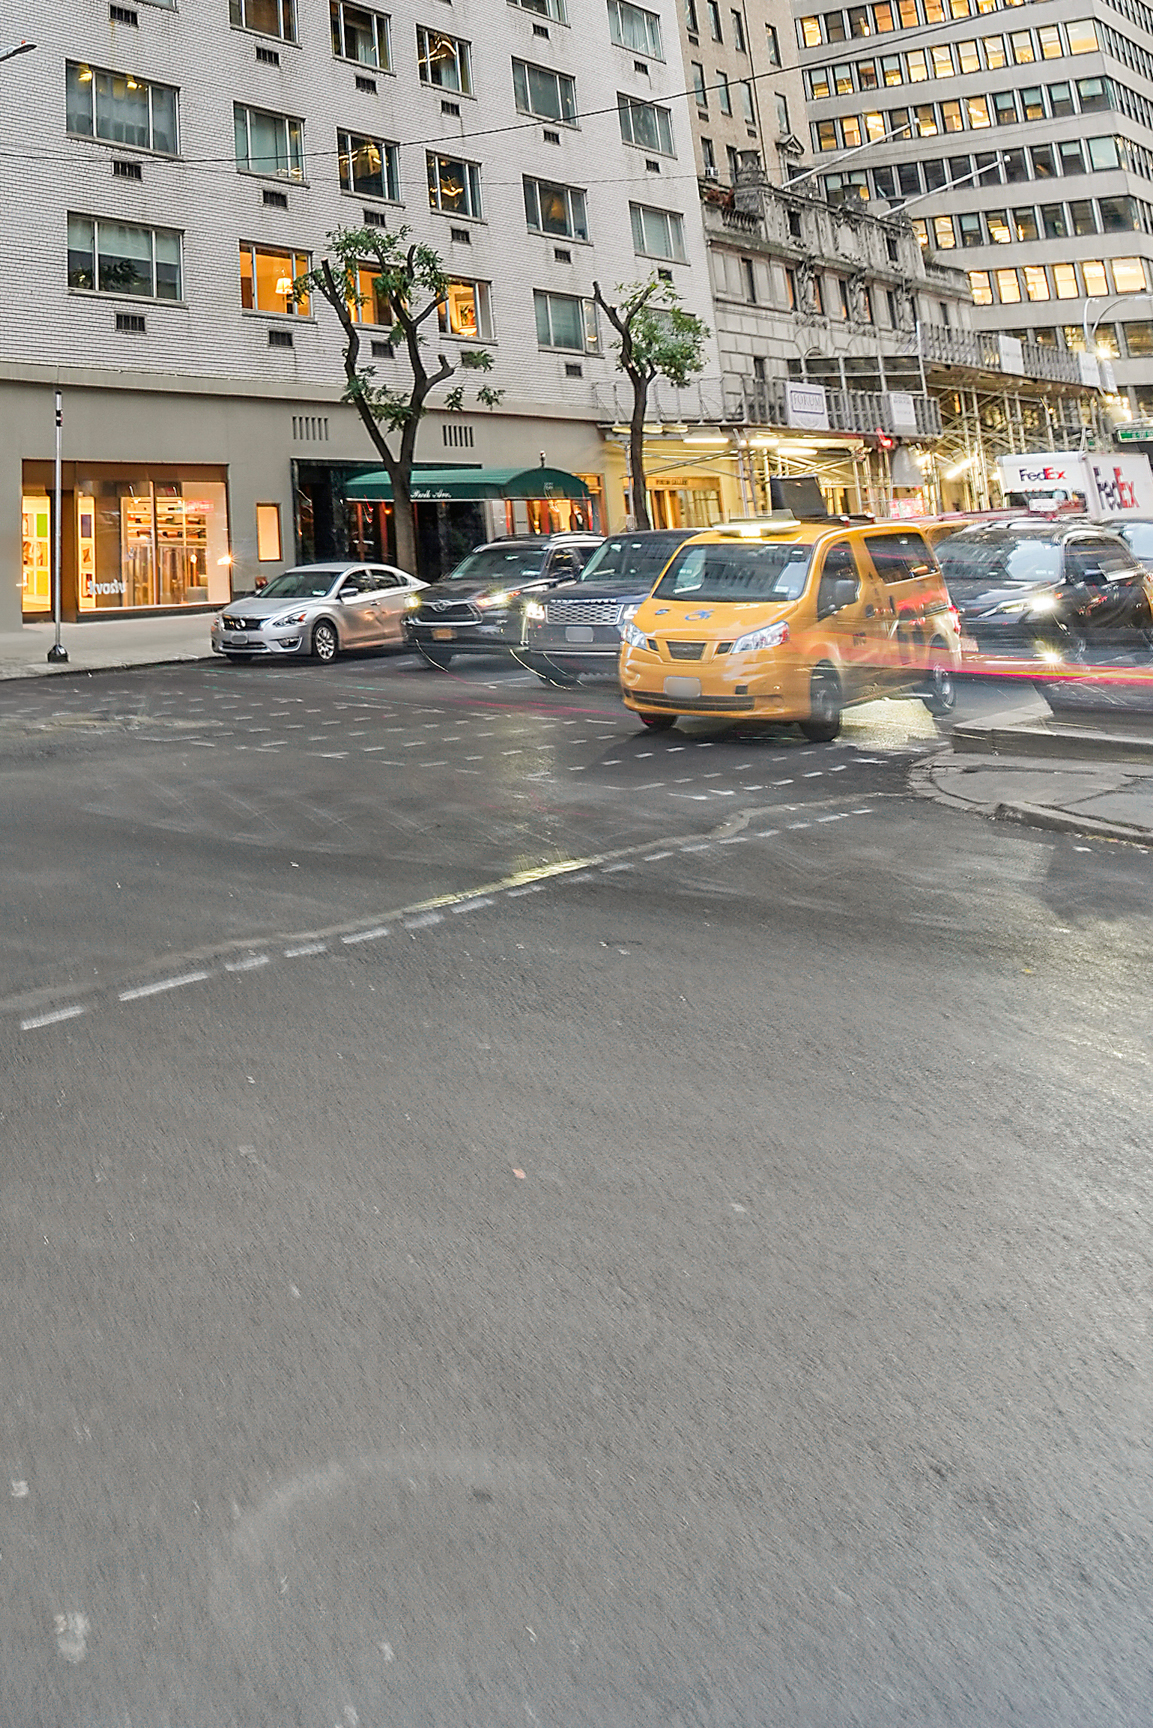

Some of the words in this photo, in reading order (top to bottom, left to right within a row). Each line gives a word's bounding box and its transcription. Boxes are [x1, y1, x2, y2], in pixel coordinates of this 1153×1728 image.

[792, 393, 822, 407] FORUM
[1019, 466, 1067, 482] FedEx
[1093, 465, 1140, 511] FedEx
